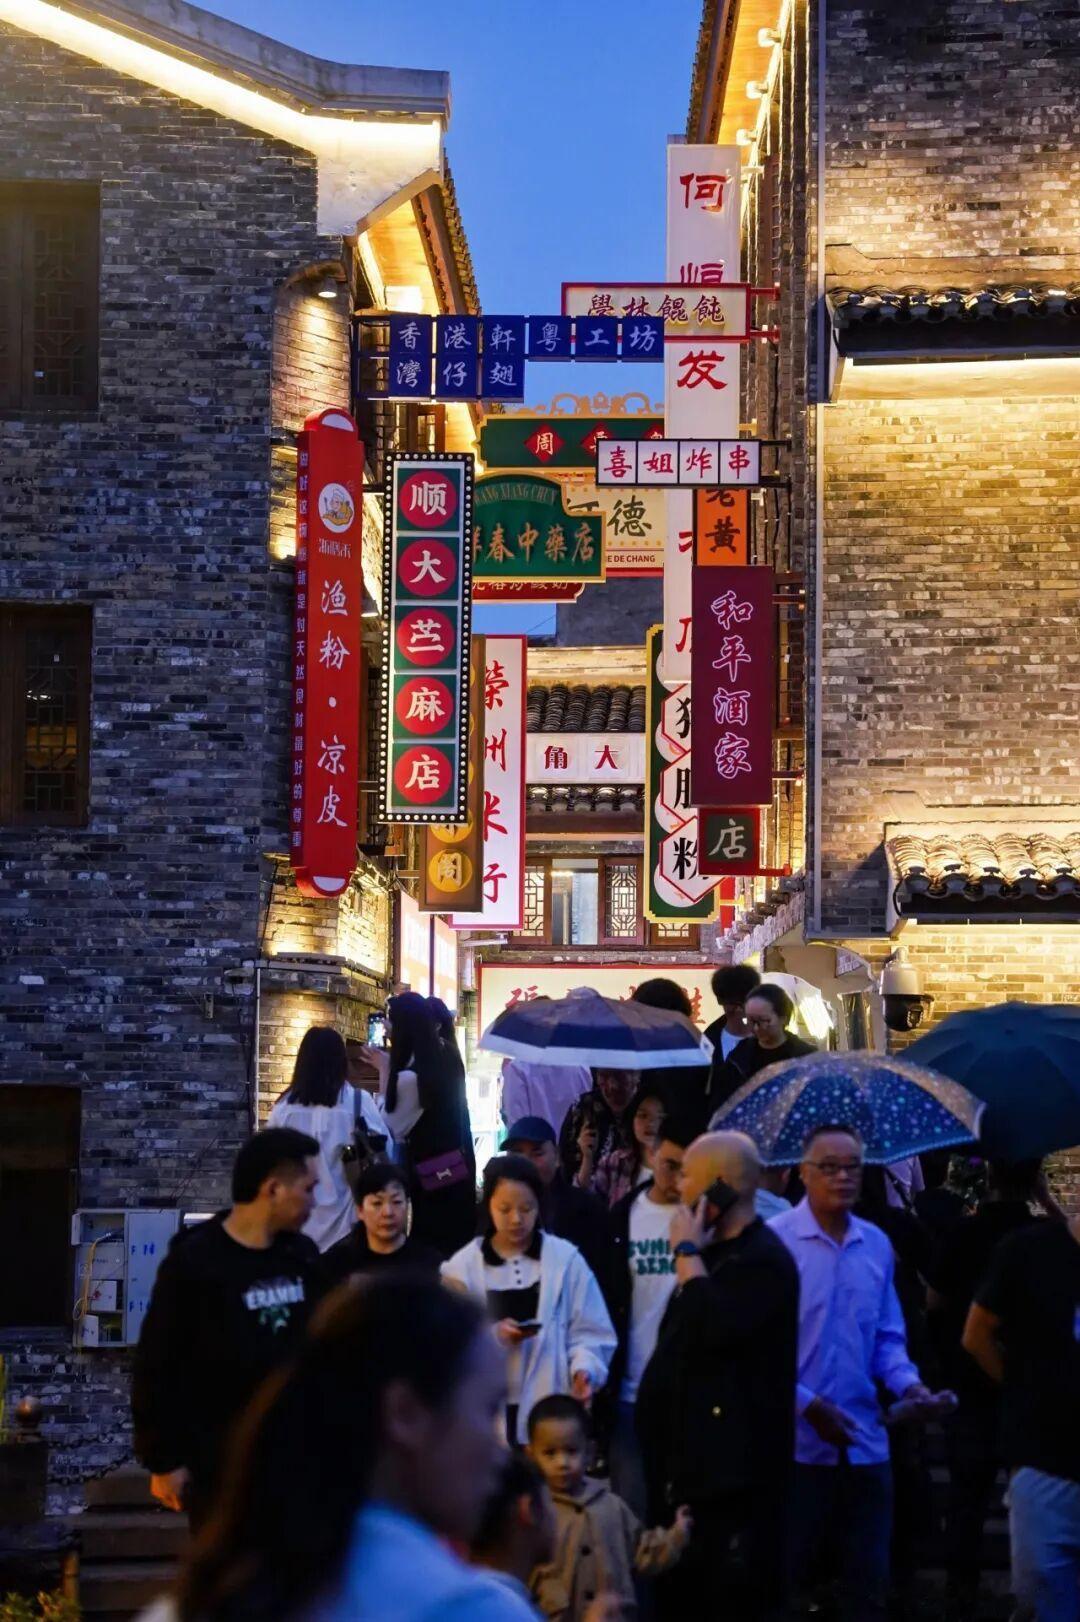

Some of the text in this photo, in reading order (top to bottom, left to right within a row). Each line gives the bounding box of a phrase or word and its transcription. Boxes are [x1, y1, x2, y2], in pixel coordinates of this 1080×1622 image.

[603, 445, 751, 479] 喜姐炸串
[626, 555, 656, 563] CHANG
[711, 590, 753, 779] 和平酒家
[708, 818, 747, 860] 店
